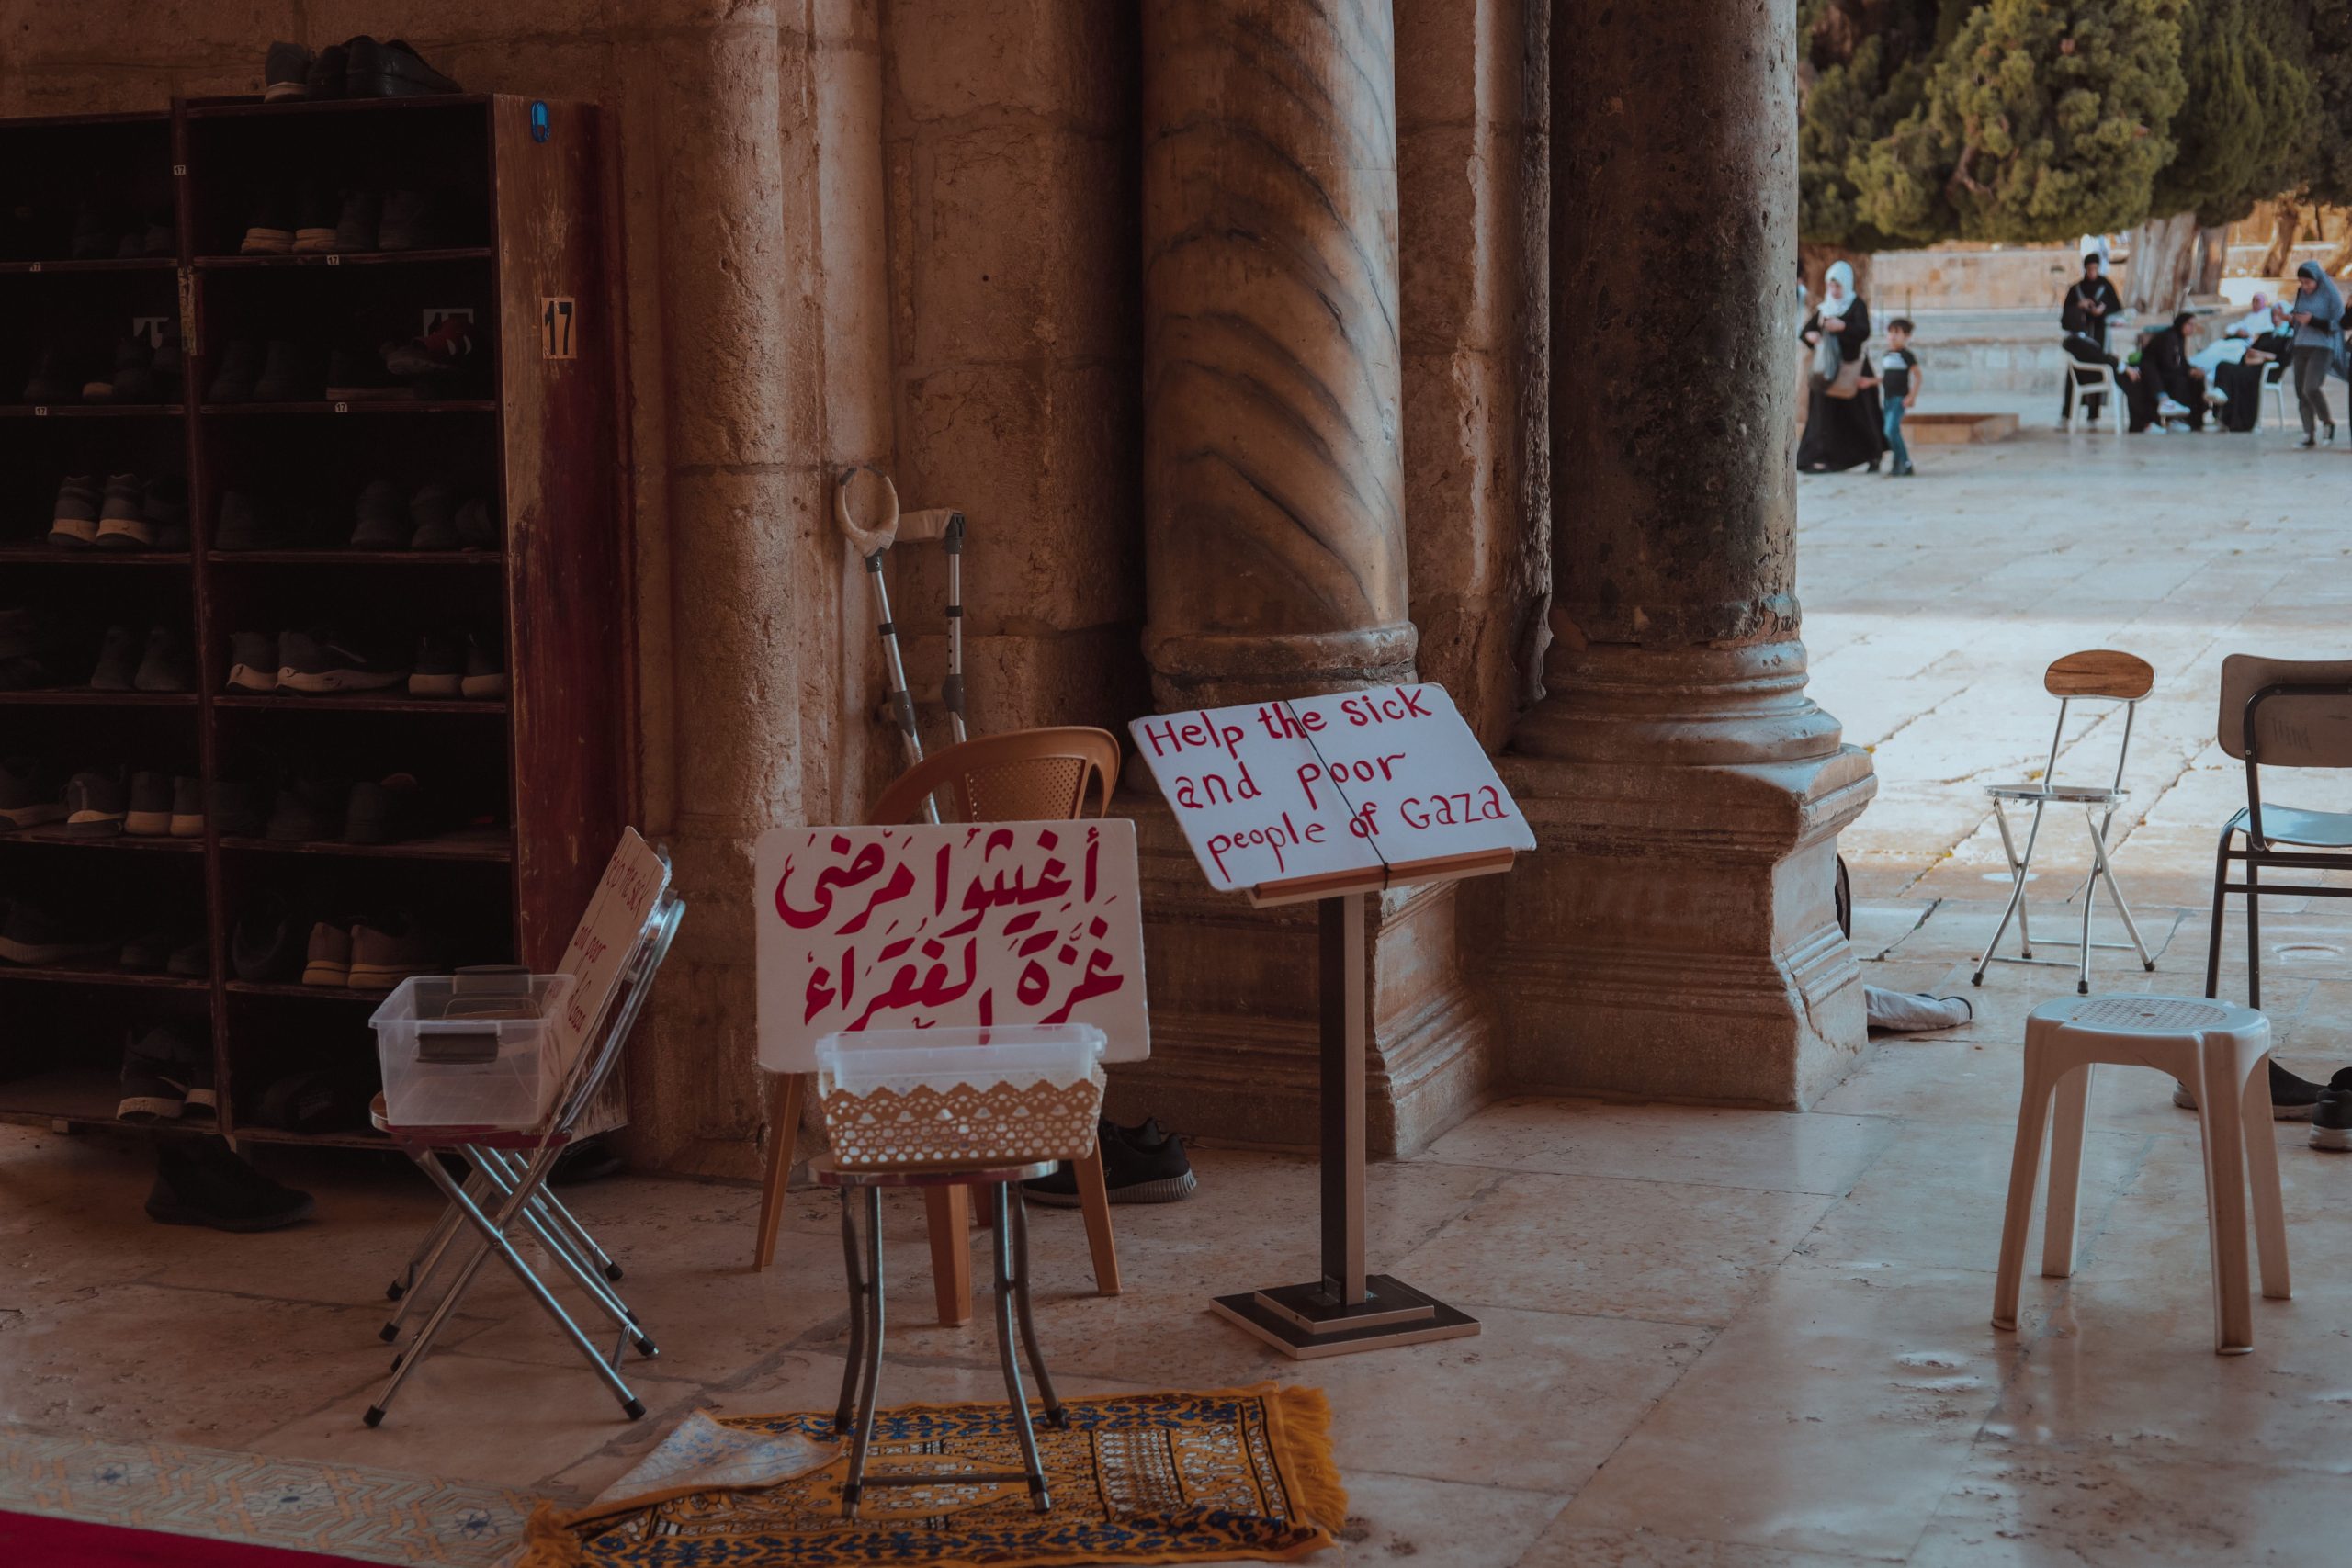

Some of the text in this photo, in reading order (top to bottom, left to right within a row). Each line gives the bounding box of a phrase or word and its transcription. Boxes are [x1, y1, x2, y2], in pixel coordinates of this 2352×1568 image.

[544, 300, 573, 355] 17
[1144, 711, 1244, 760] Help
[1258, 703, 1328, 739] the
[1175, 752, 1406, 810] and poor
[1207, 785, 1510, 883] people of Gaza
